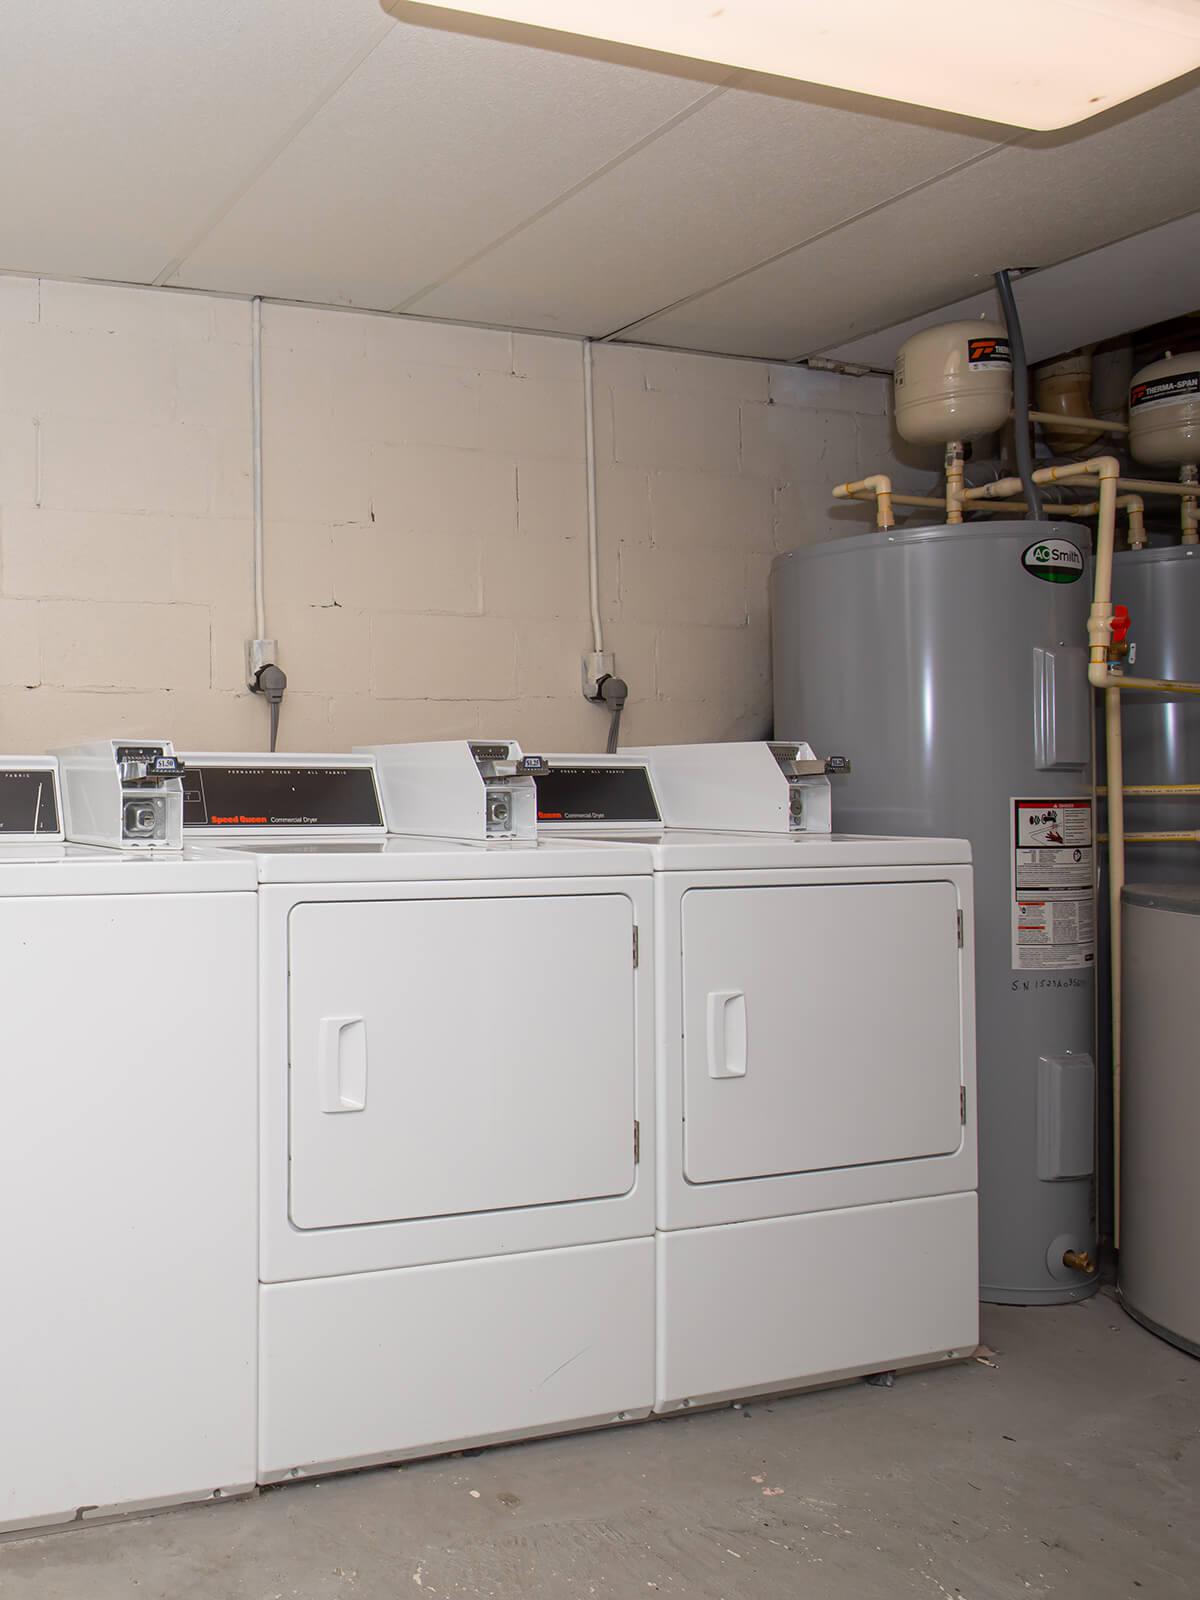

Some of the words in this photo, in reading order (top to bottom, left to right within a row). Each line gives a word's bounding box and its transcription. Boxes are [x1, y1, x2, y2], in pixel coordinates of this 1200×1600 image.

[1146, 378, 1198, 395] THERMA-SPAN
[211, 815, 239, 824] Speed
[240, 815, 267, 823] Queen
[303, 816, 318, 824] Dryer
